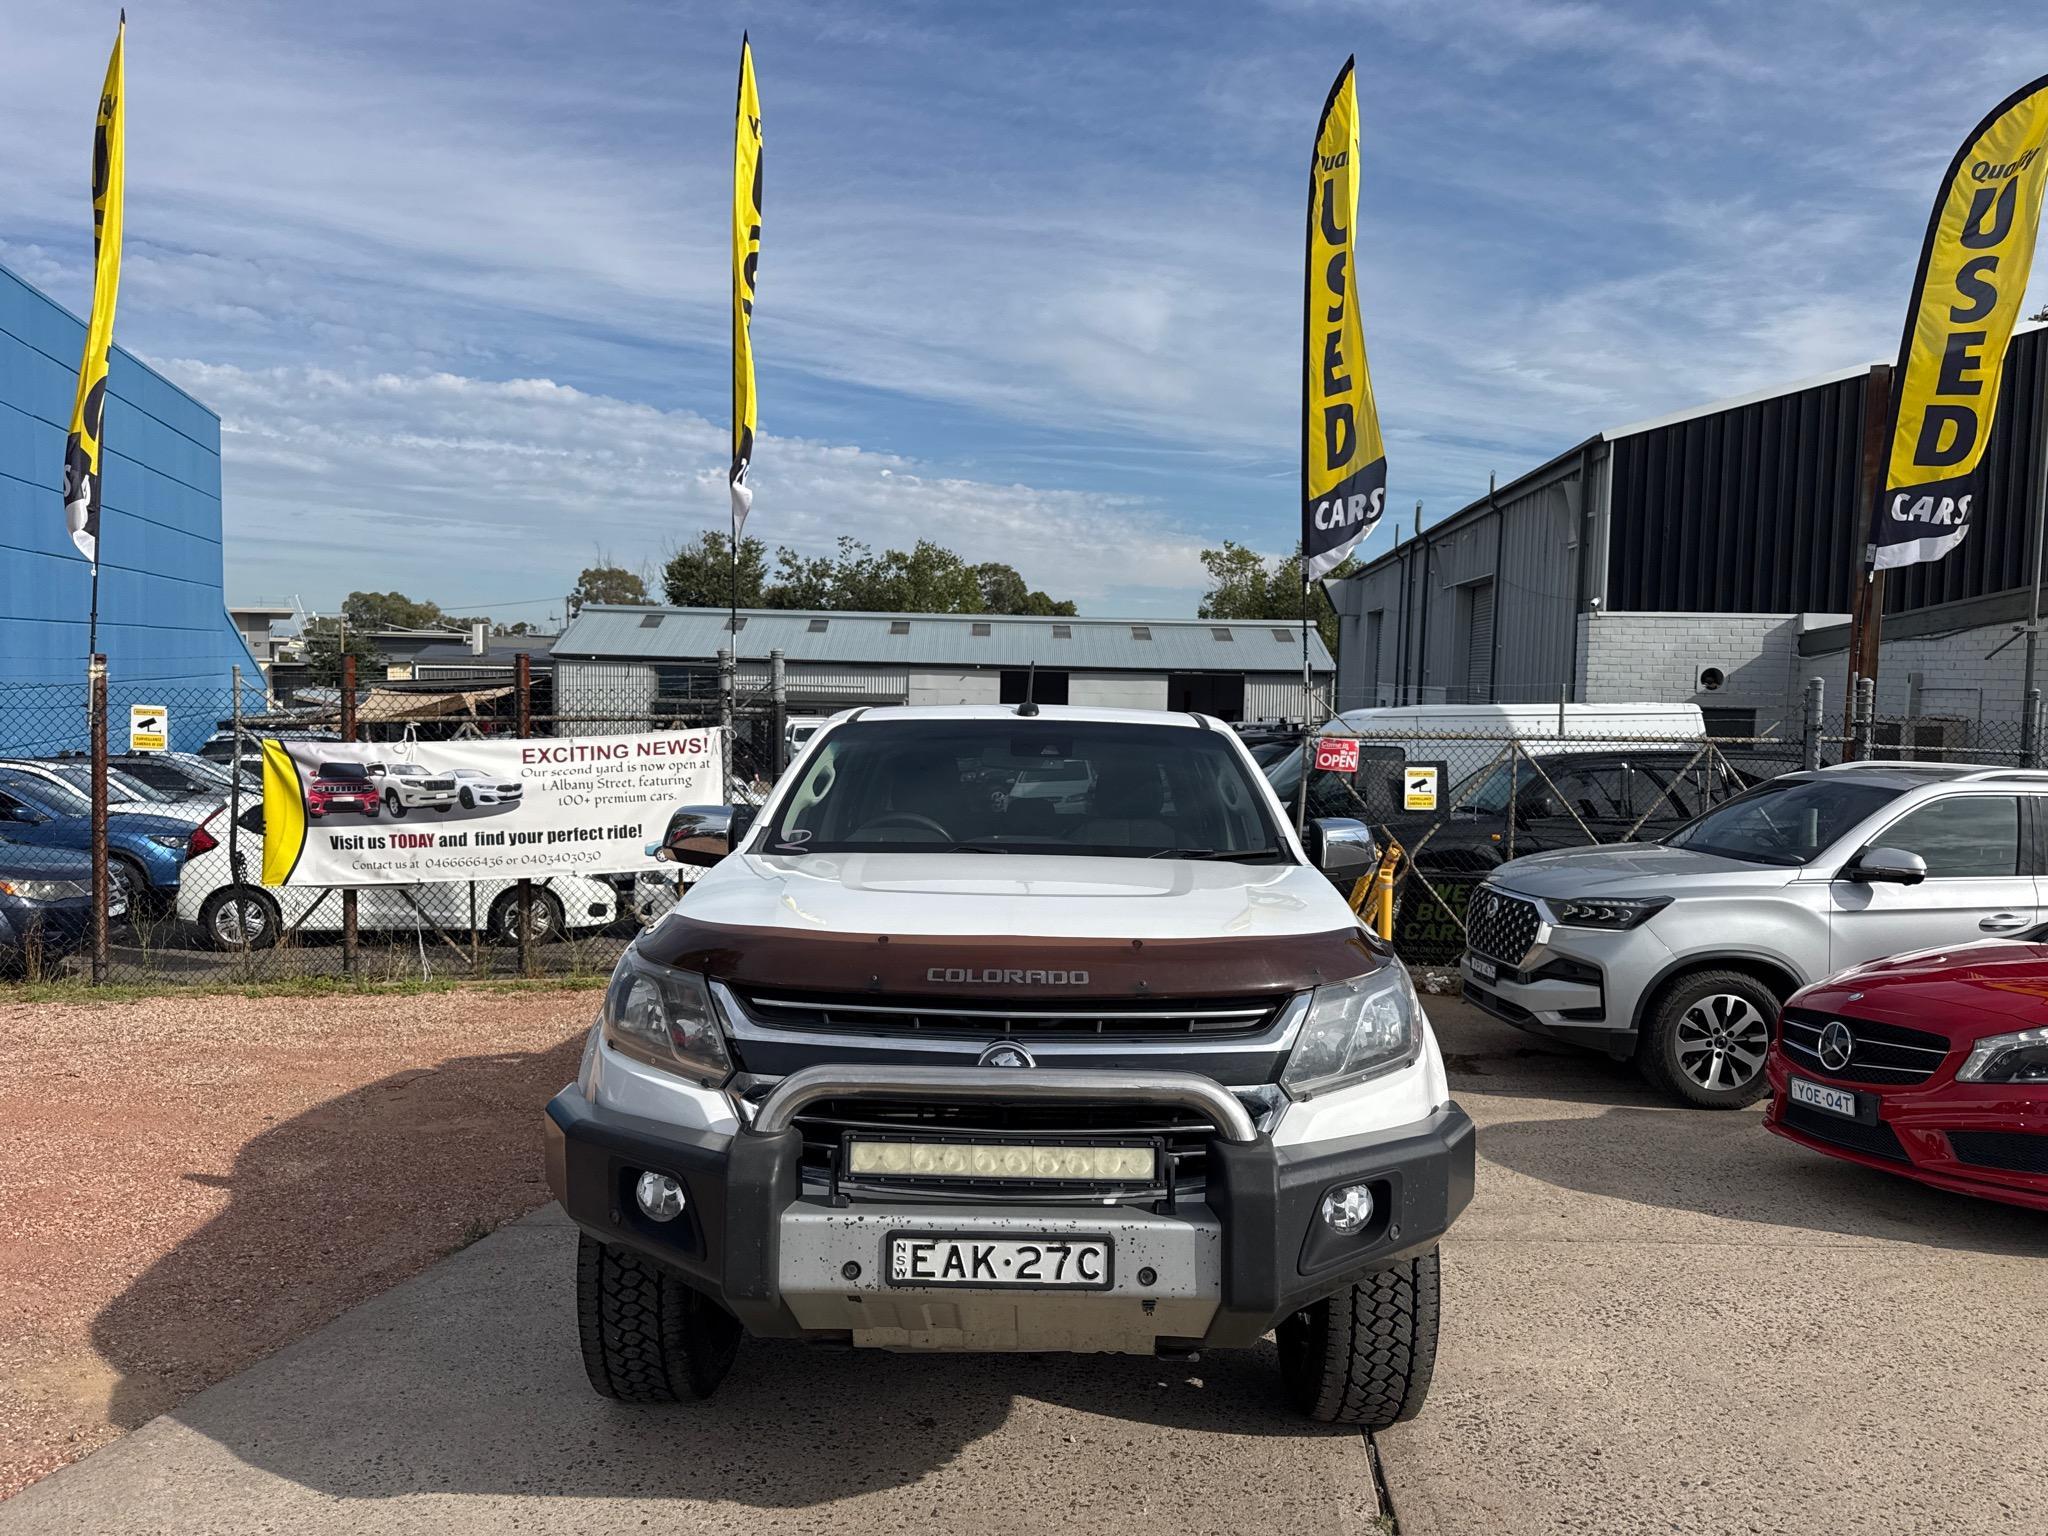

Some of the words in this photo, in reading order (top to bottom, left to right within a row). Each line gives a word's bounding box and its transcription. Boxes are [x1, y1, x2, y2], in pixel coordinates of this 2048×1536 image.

[1912, 175, 2019, 467] USED
[1314, 487, 1385, 531] CARS
[1891, 493, 1973, 525] CARS
[522, 743, 629, 764] EXCITING
[637, 737, 709, 757] NEWS!
[1319, 753, 1357, 768] OPEN
[521, 767, 547, 778] Our
[551, 764, 592, 777] second
[595, 761, 623, 777] yard
[627, 760, 637, 773] is
[640, 761, 666, 772] now
[668, 761, 696, 775] open
[700, 759, 710, 769] at
[550, 777, 594, 794] Albany
[638, 773, 693, 788] featuring
[558, 794, 590, 806] 100+
[595, 791, 647, 808] premium
[650, 790, 678, 801] cars.
[329, 835, 365, 850] Visit
[367, 837, 386, 849] us
[389, 833, 435, 849] TODAY
[439, 832, 467, 847] and
[475, 830, 505, 846] find
[509, 831, 544, 846] your
[547, 826, 604, 844] perfect
[607, 824, 643, 840] ride!
[352, 859, 392, 870] Contact
[395, 859, 407, 869] us
[410, 859, 419, 869] at
[425, 856, 503, 868] 0466666436
[506, 857, 517, 865] or
[521, 850, 601, 865] 0403403030
[927, 967, 1090, 985] COLORADO
[894, 1242, 908, 1278] NSW
